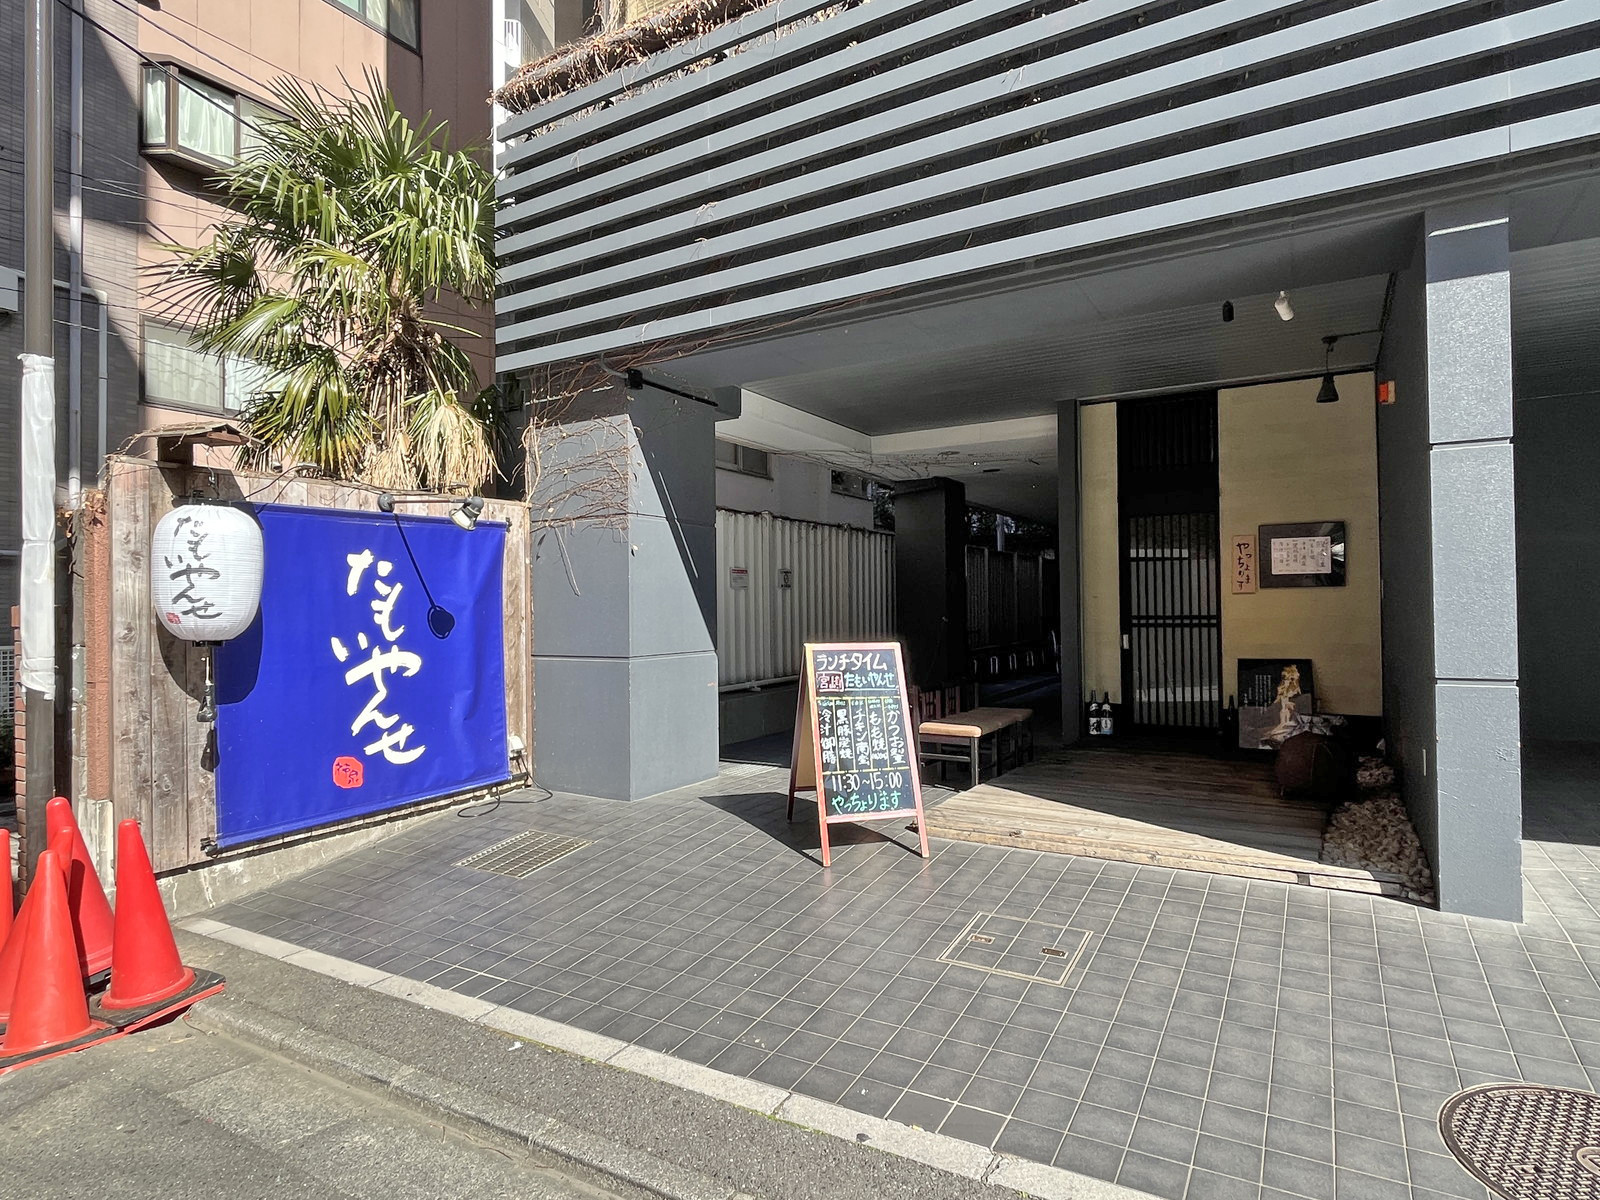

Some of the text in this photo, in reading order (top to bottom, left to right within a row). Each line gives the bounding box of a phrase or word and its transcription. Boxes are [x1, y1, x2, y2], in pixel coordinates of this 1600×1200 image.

[164, 515, 222, 620] たもいやんせ
[330, 548, 426, 765] たもいやんせ
[815, 652, 888, 671] ランチタイム
[844, 672, 896, 688] たもいやんせ
[853, 708, 870, 766] チキン南蛮
[869, 711, 887, 752] もも焼
[831, 791, 902, 814] やっちょります
